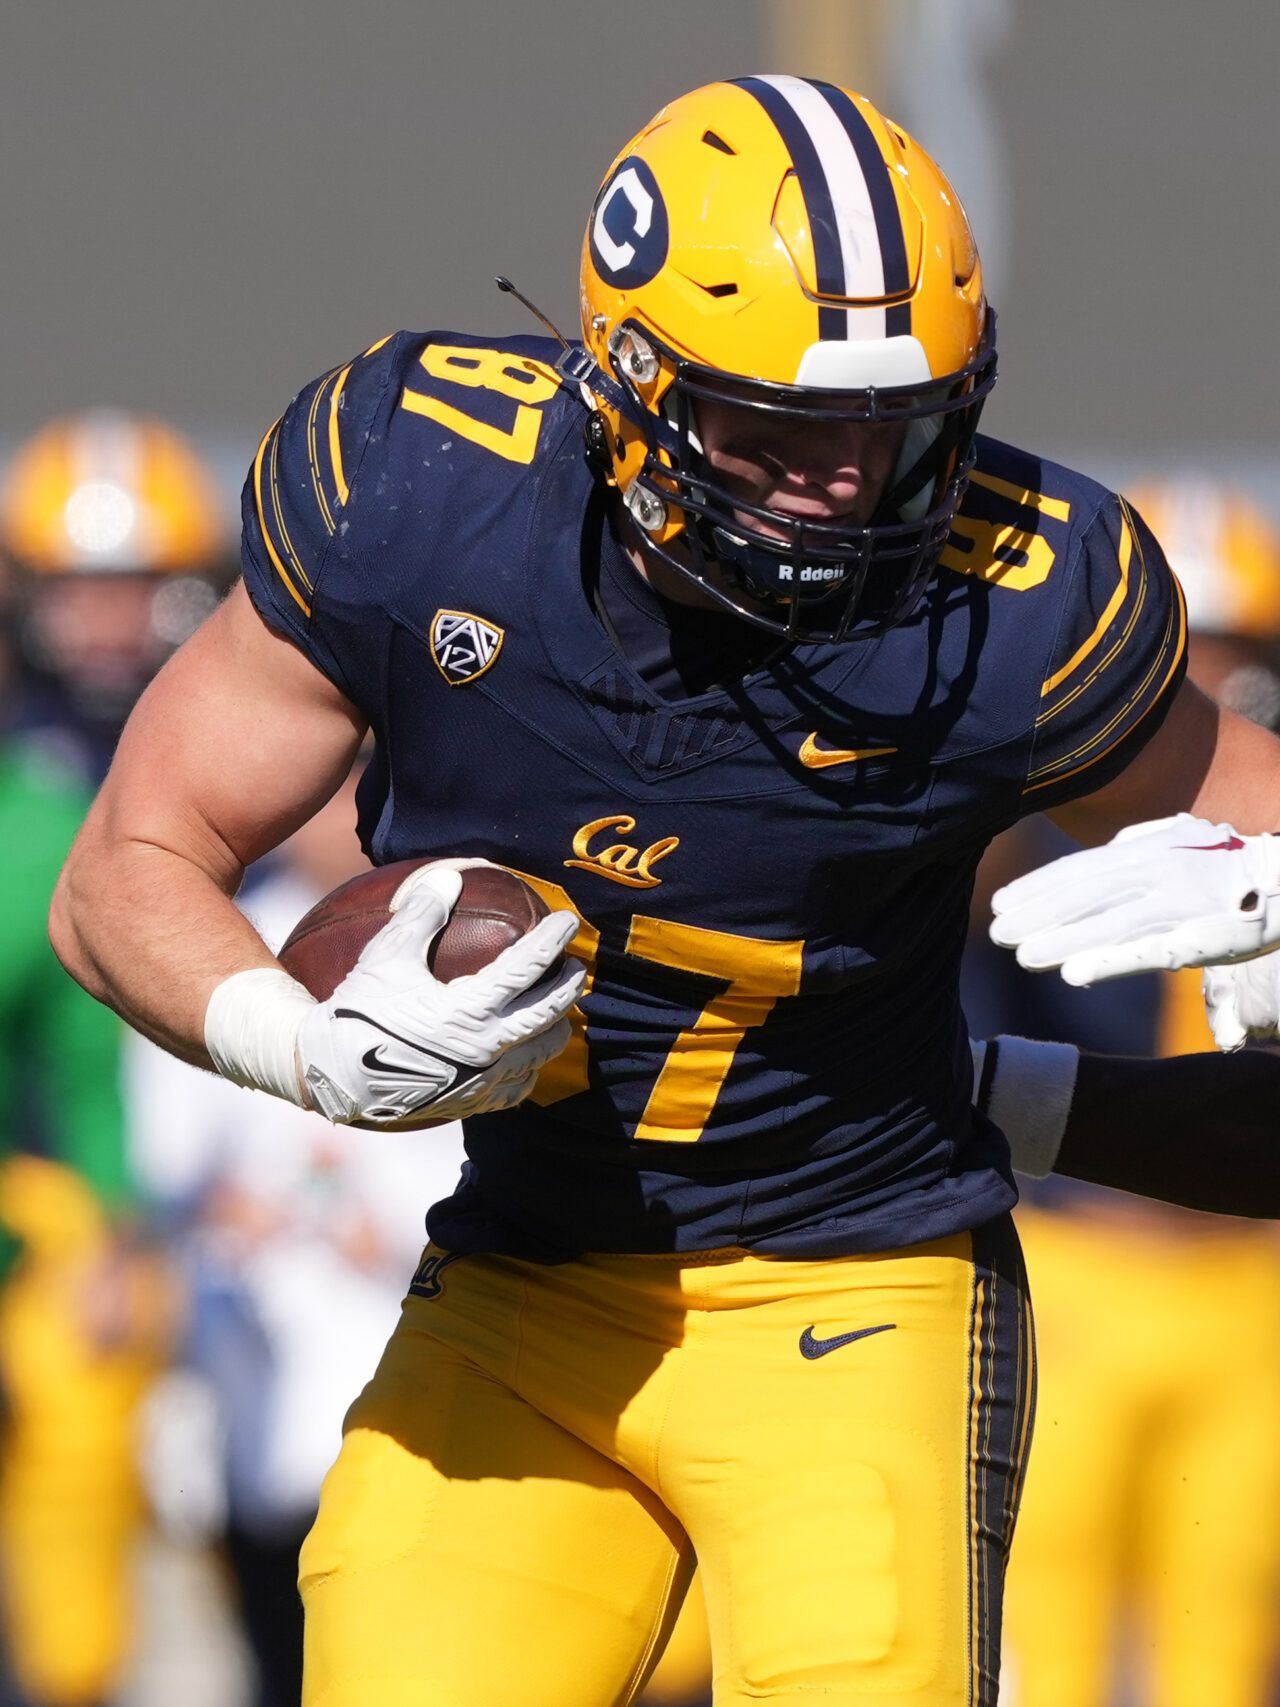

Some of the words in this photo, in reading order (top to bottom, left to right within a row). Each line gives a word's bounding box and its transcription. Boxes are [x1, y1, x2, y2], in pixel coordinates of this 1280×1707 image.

[593, 168, 654, 273] C
[401, 344, 564, 465] 87
[778, 562, 845, 582] Rddell
[435, 614, 499, 668] PAC
[440, 644, 472, 676] 12
[563, 814, 680, 889] Cal
